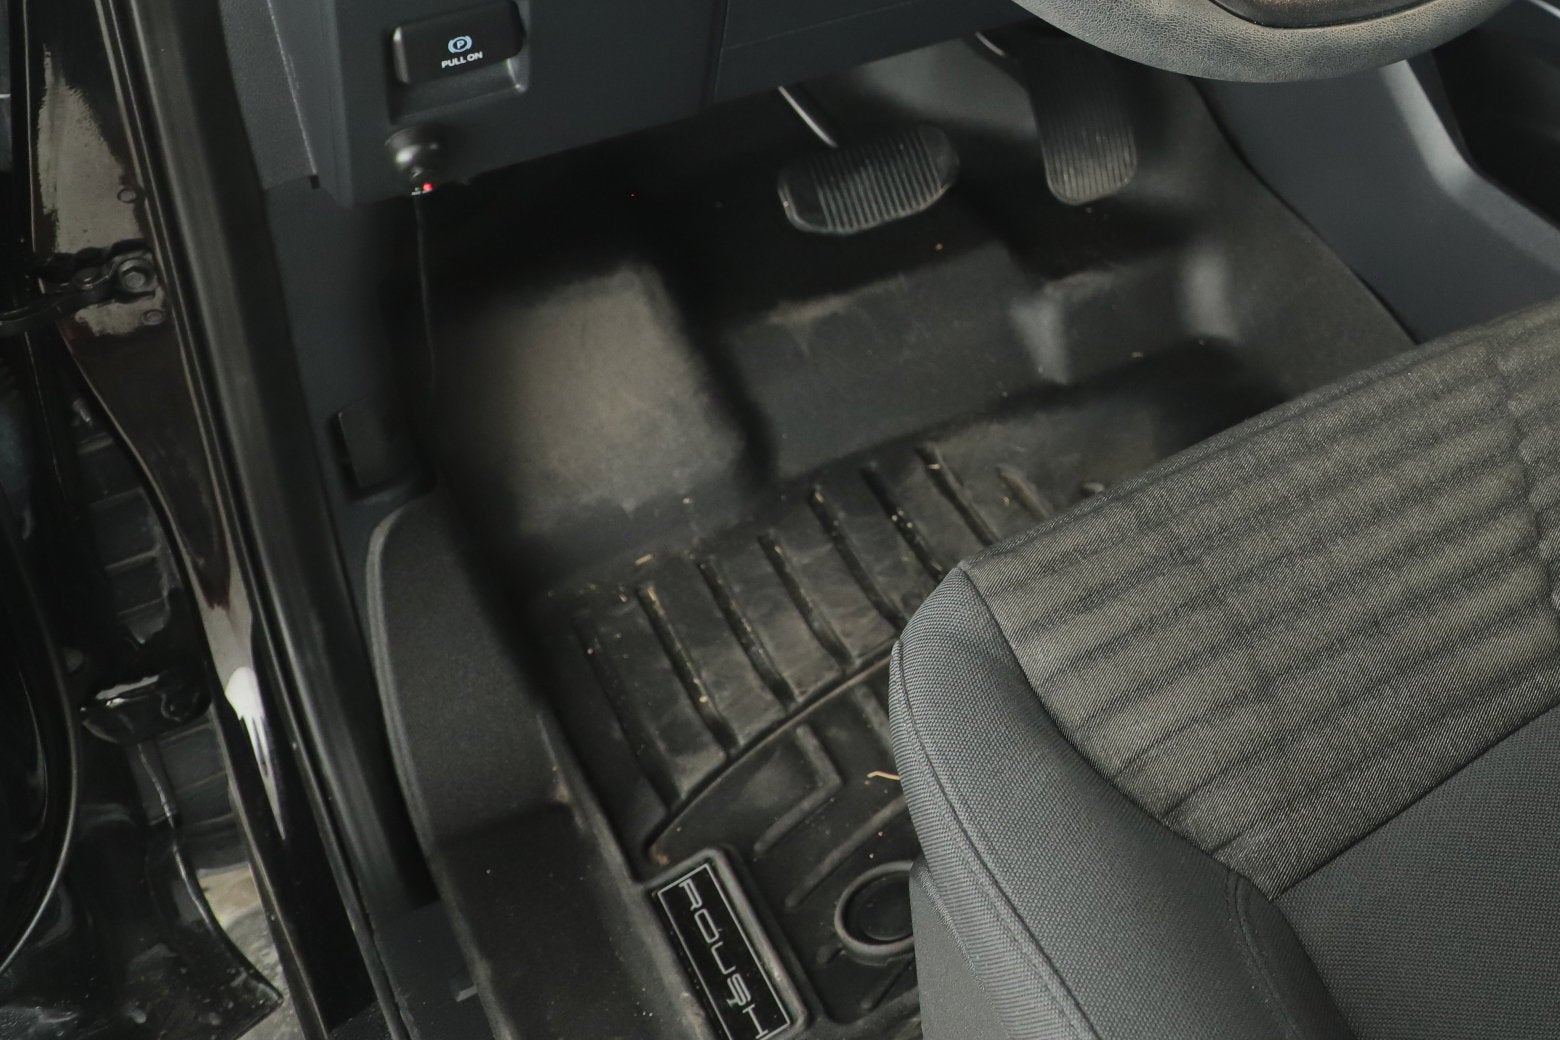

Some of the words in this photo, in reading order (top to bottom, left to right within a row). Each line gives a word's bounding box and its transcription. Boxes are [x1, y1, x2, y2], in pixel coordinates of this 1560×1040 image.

[441, 56, 467, 68] PULL
[467, 51, 483, 61] ON
[677, 878, 769, 1039] ROUSH
